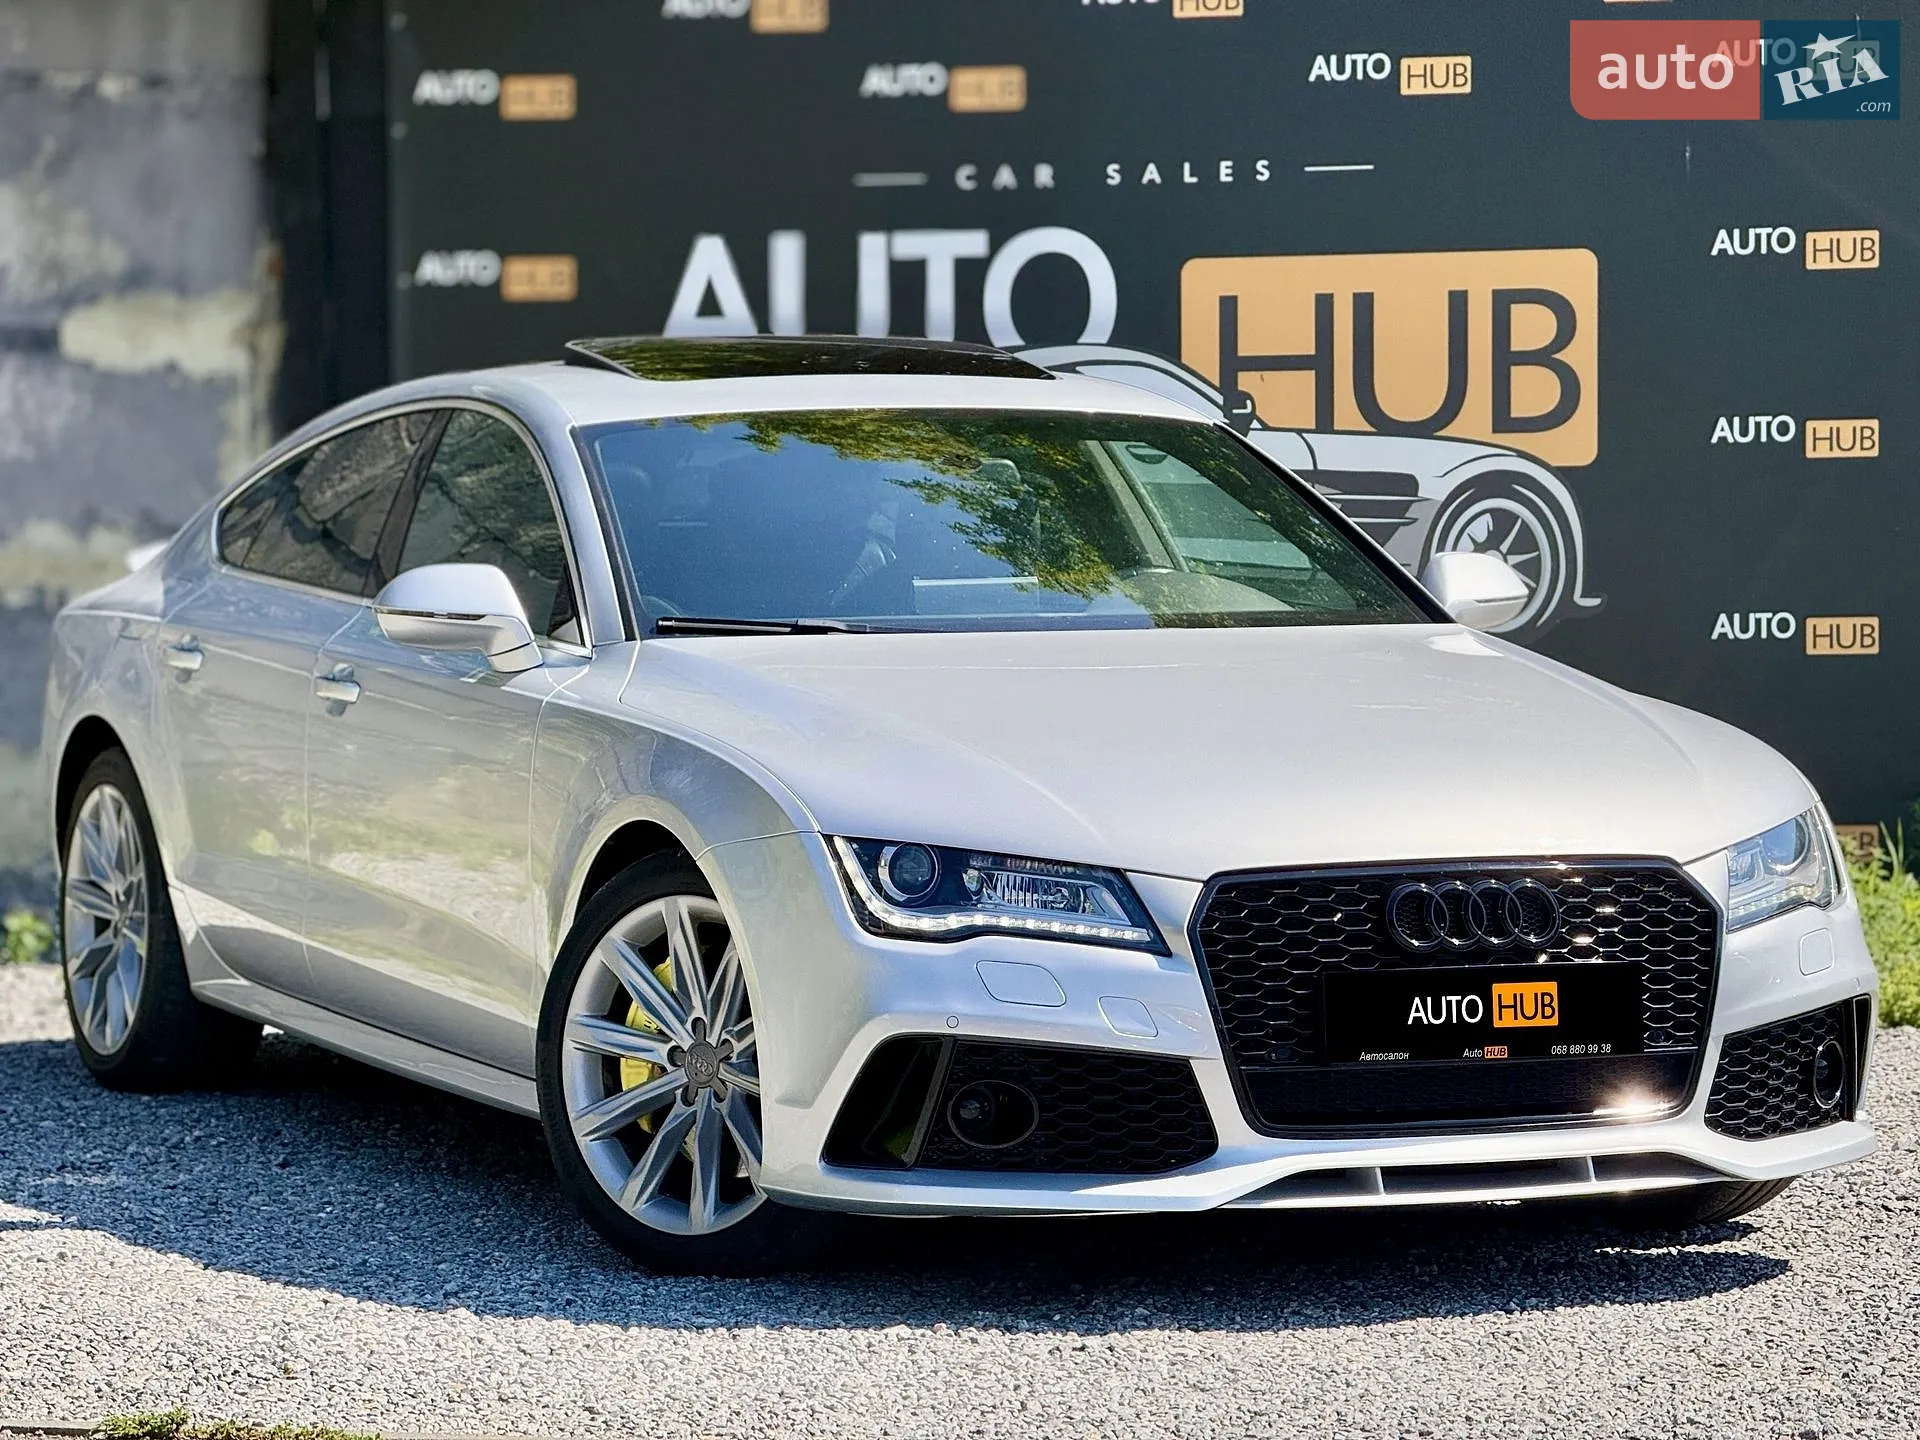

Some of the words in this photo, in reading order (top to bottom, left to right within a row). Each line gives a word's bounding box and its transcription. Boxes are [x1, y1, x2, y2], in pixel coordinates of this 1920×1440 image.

[1308, 53, 1391, 82] AUTO
[1407, 63, 1468, 88] HUB
[954, 163, 1055, 191] CAR
[1106, 159, 1271, 186] SALES
[1710, 227, 1796, 256] AUTO
[1813, 237, 1876, 263] HUB
[1219, 288, 1581, 436] HUB
[1710, 415, 1796, 444] AUTO
[1812, 426, 1876, 452] HUB
[1710, 612, 1796, 640] AUTO
[1812, 623, 1876, 648] HUB
[1407, 995, 1483, 1025] AUTO
[1497, 992, 1556, 1022] HUB
[1359, 1051, 1410, 1062] Автосалон
[1462, 1048, 1483, 1058] Auto
[1486, 1047, 1506, 1057] HUB
[1551, 1045, 1567, 1055] 068
[1569, 1045, 1585, 1054] 880
[1587, 1044, 1599, 1054] 99
[1600, 1043, 1612, 1053] 38
